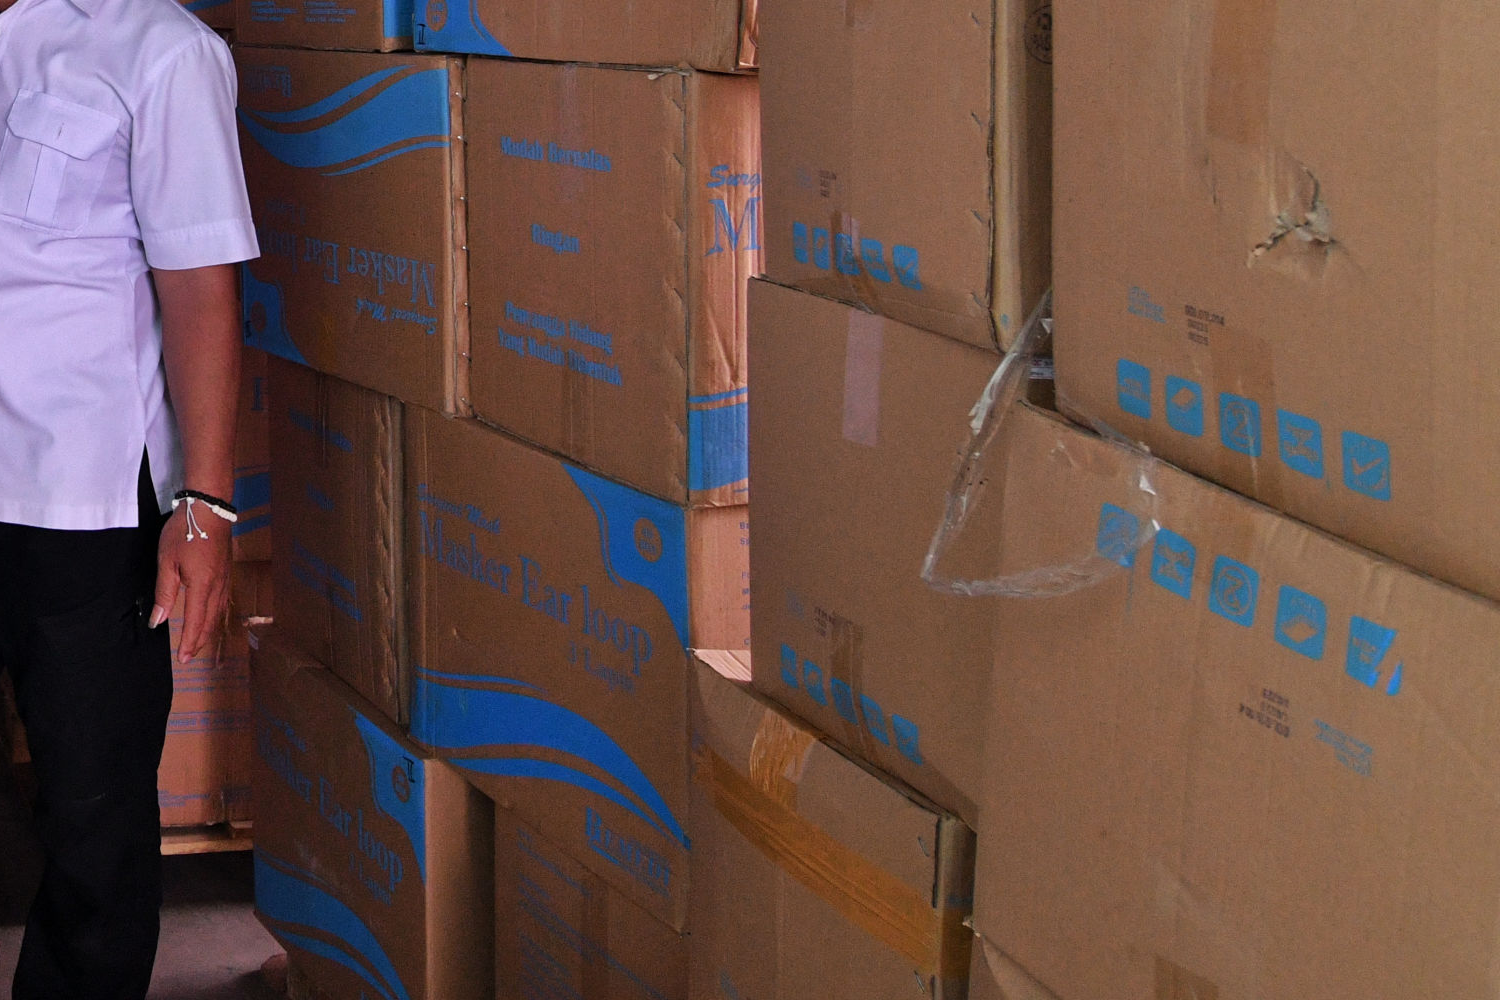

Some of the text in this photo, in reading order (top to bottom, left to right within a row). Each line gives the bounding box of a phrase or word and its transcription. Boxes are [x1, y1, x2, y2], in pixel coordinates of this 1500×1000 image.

[501, 135, 545, 162] Mudah
[706, 163, 762, 193] Surg
[530, 222, 581, 255] Ringan
[704, 195, 762, 257] M
[347, 245, 437, 308] Masker
[419, 509, 512, 595] Masker
[519, 553, 573, 626] Ear
[581, 584, 654, 678] loop
